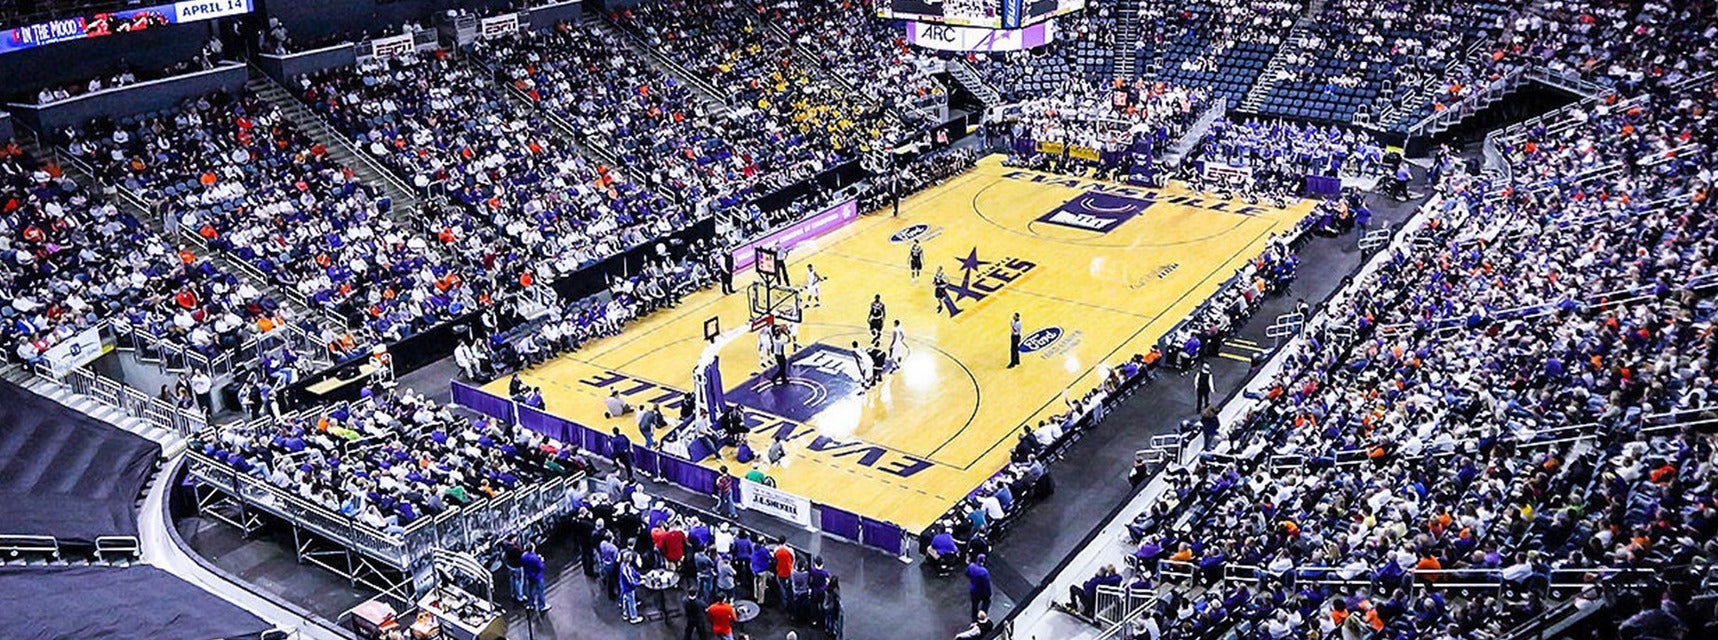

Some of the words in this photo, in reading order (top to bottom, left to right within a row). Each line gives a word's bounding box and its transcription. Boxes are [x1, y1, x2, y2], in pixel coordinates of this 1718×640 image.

[183, 2, 223, 17] APRIL
[228, 0, 242, 10] 14
[21, 26, 33, 44] IN
[32, 24, 50, 45] THE
[50, 19, 77, 37] MOOD
[487, 18, 517, 34] ESPN
[921, 26, 956, 42] ARC
[376, 39, 412, 57] ESPN
[945, 248, 1036, 319] ACES
[1023, 330, 1058, 351] Ford
